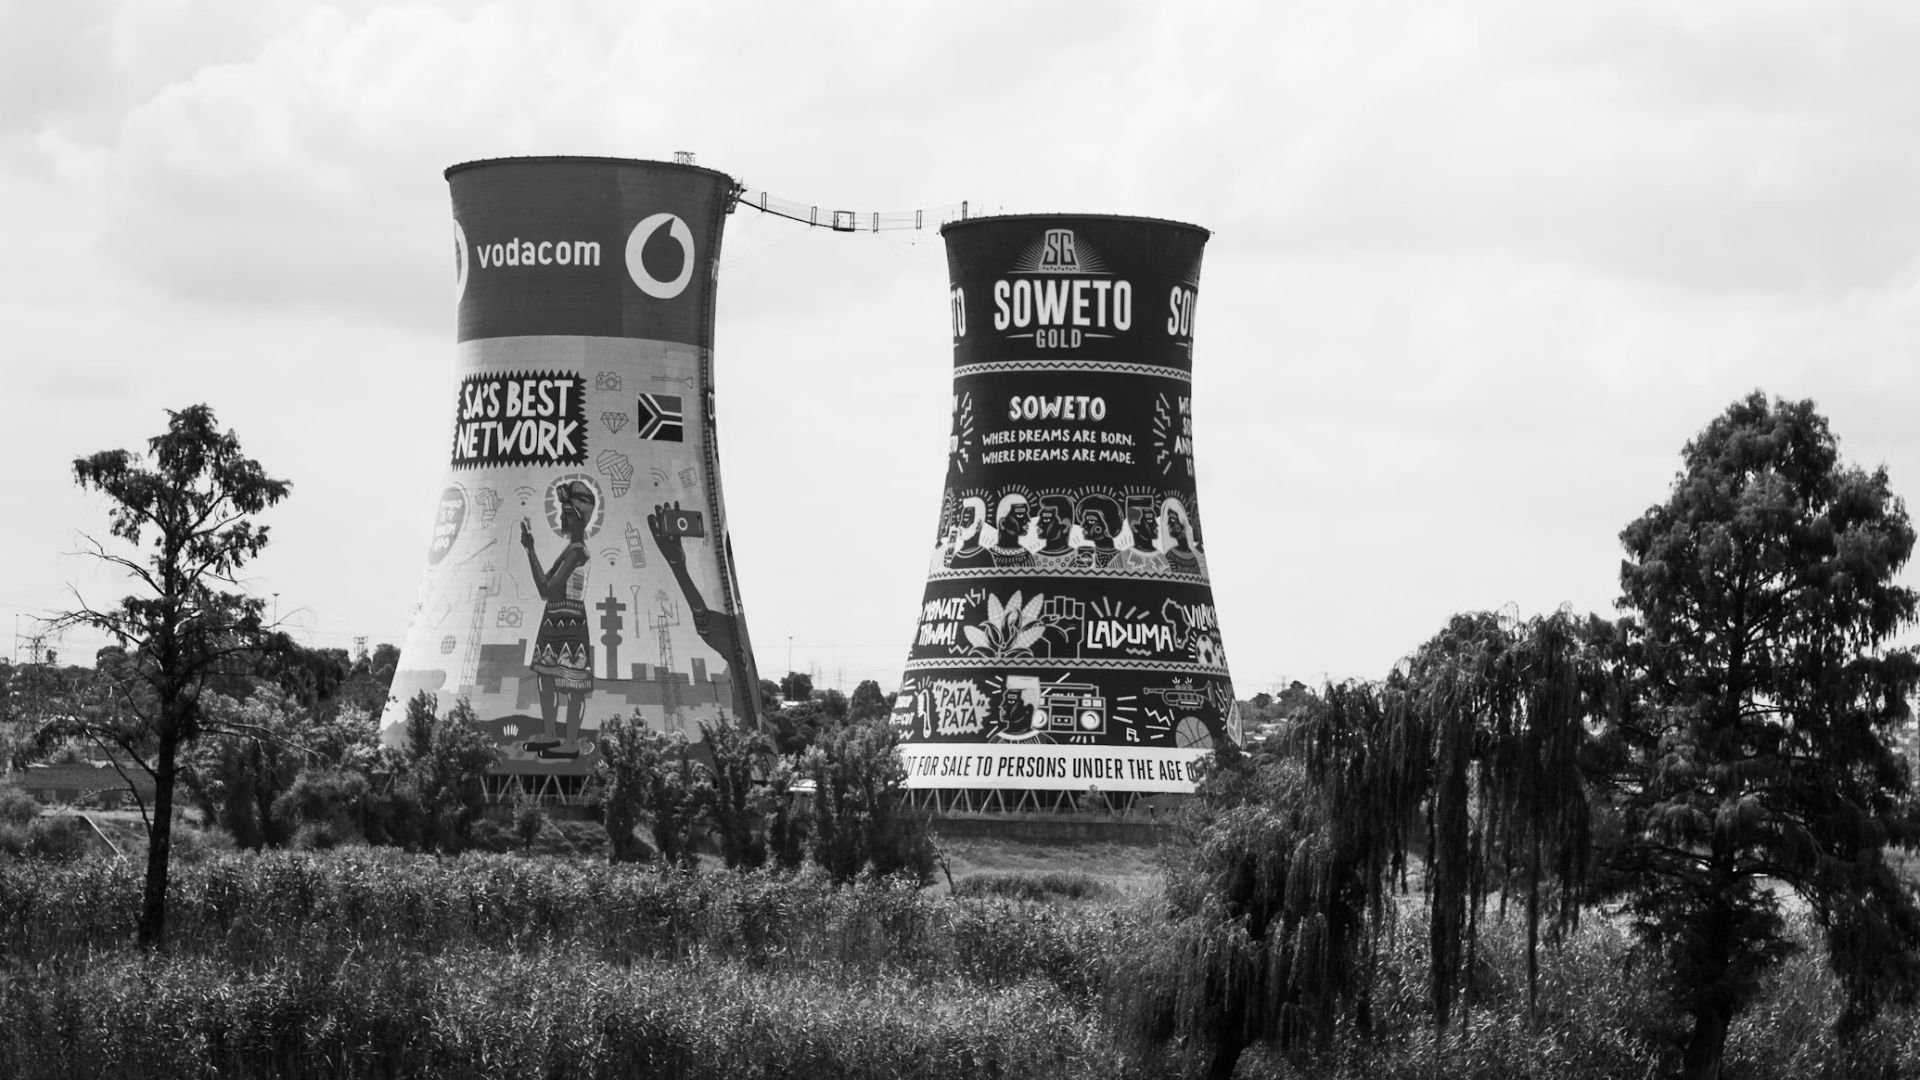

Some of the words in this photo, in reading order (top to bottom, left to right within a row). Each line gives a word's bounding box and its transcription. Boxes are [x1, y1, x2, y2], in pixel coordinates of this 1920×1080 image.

[477, 238, 600, 268] vodacom
[994, 279, 1132, 331] SOWETO
[1036, 329, 1081, 348] GOLD
[463, 380, 500, 420] SA'S
[506, 380, 573, 418] BEST
[1008, 395, 1106, 421] SOWETO
[455, 419, 579, 460] NETWORK
[982, 431, 1016, 446] WHERE
[1018, 429, 1070, 443] DREAMS
[1072, 429, 1096, 443] ARE
[1101, 432, 1136, 446] BORN.
[982, 450, 1016, 464] WHERE
[1018, 448, 1069, 463] DREAMS
[1072, 449, 1096, 463] ARE
[1100, 450, 1135, 464] MADE.
[1087, 620, 1174, 652] LADUMA
[917, 755, 939, 776] FOR
[941, 756, 972, 776] SALE
[977, 756, 993, 776] TO
[998, 756, 1066, 778] PERSONS
[1073, 757, 1123, 779] UNDER
[1128, 759, 1155, 780] THE
[1160, 760, 1183, 781] AGE
